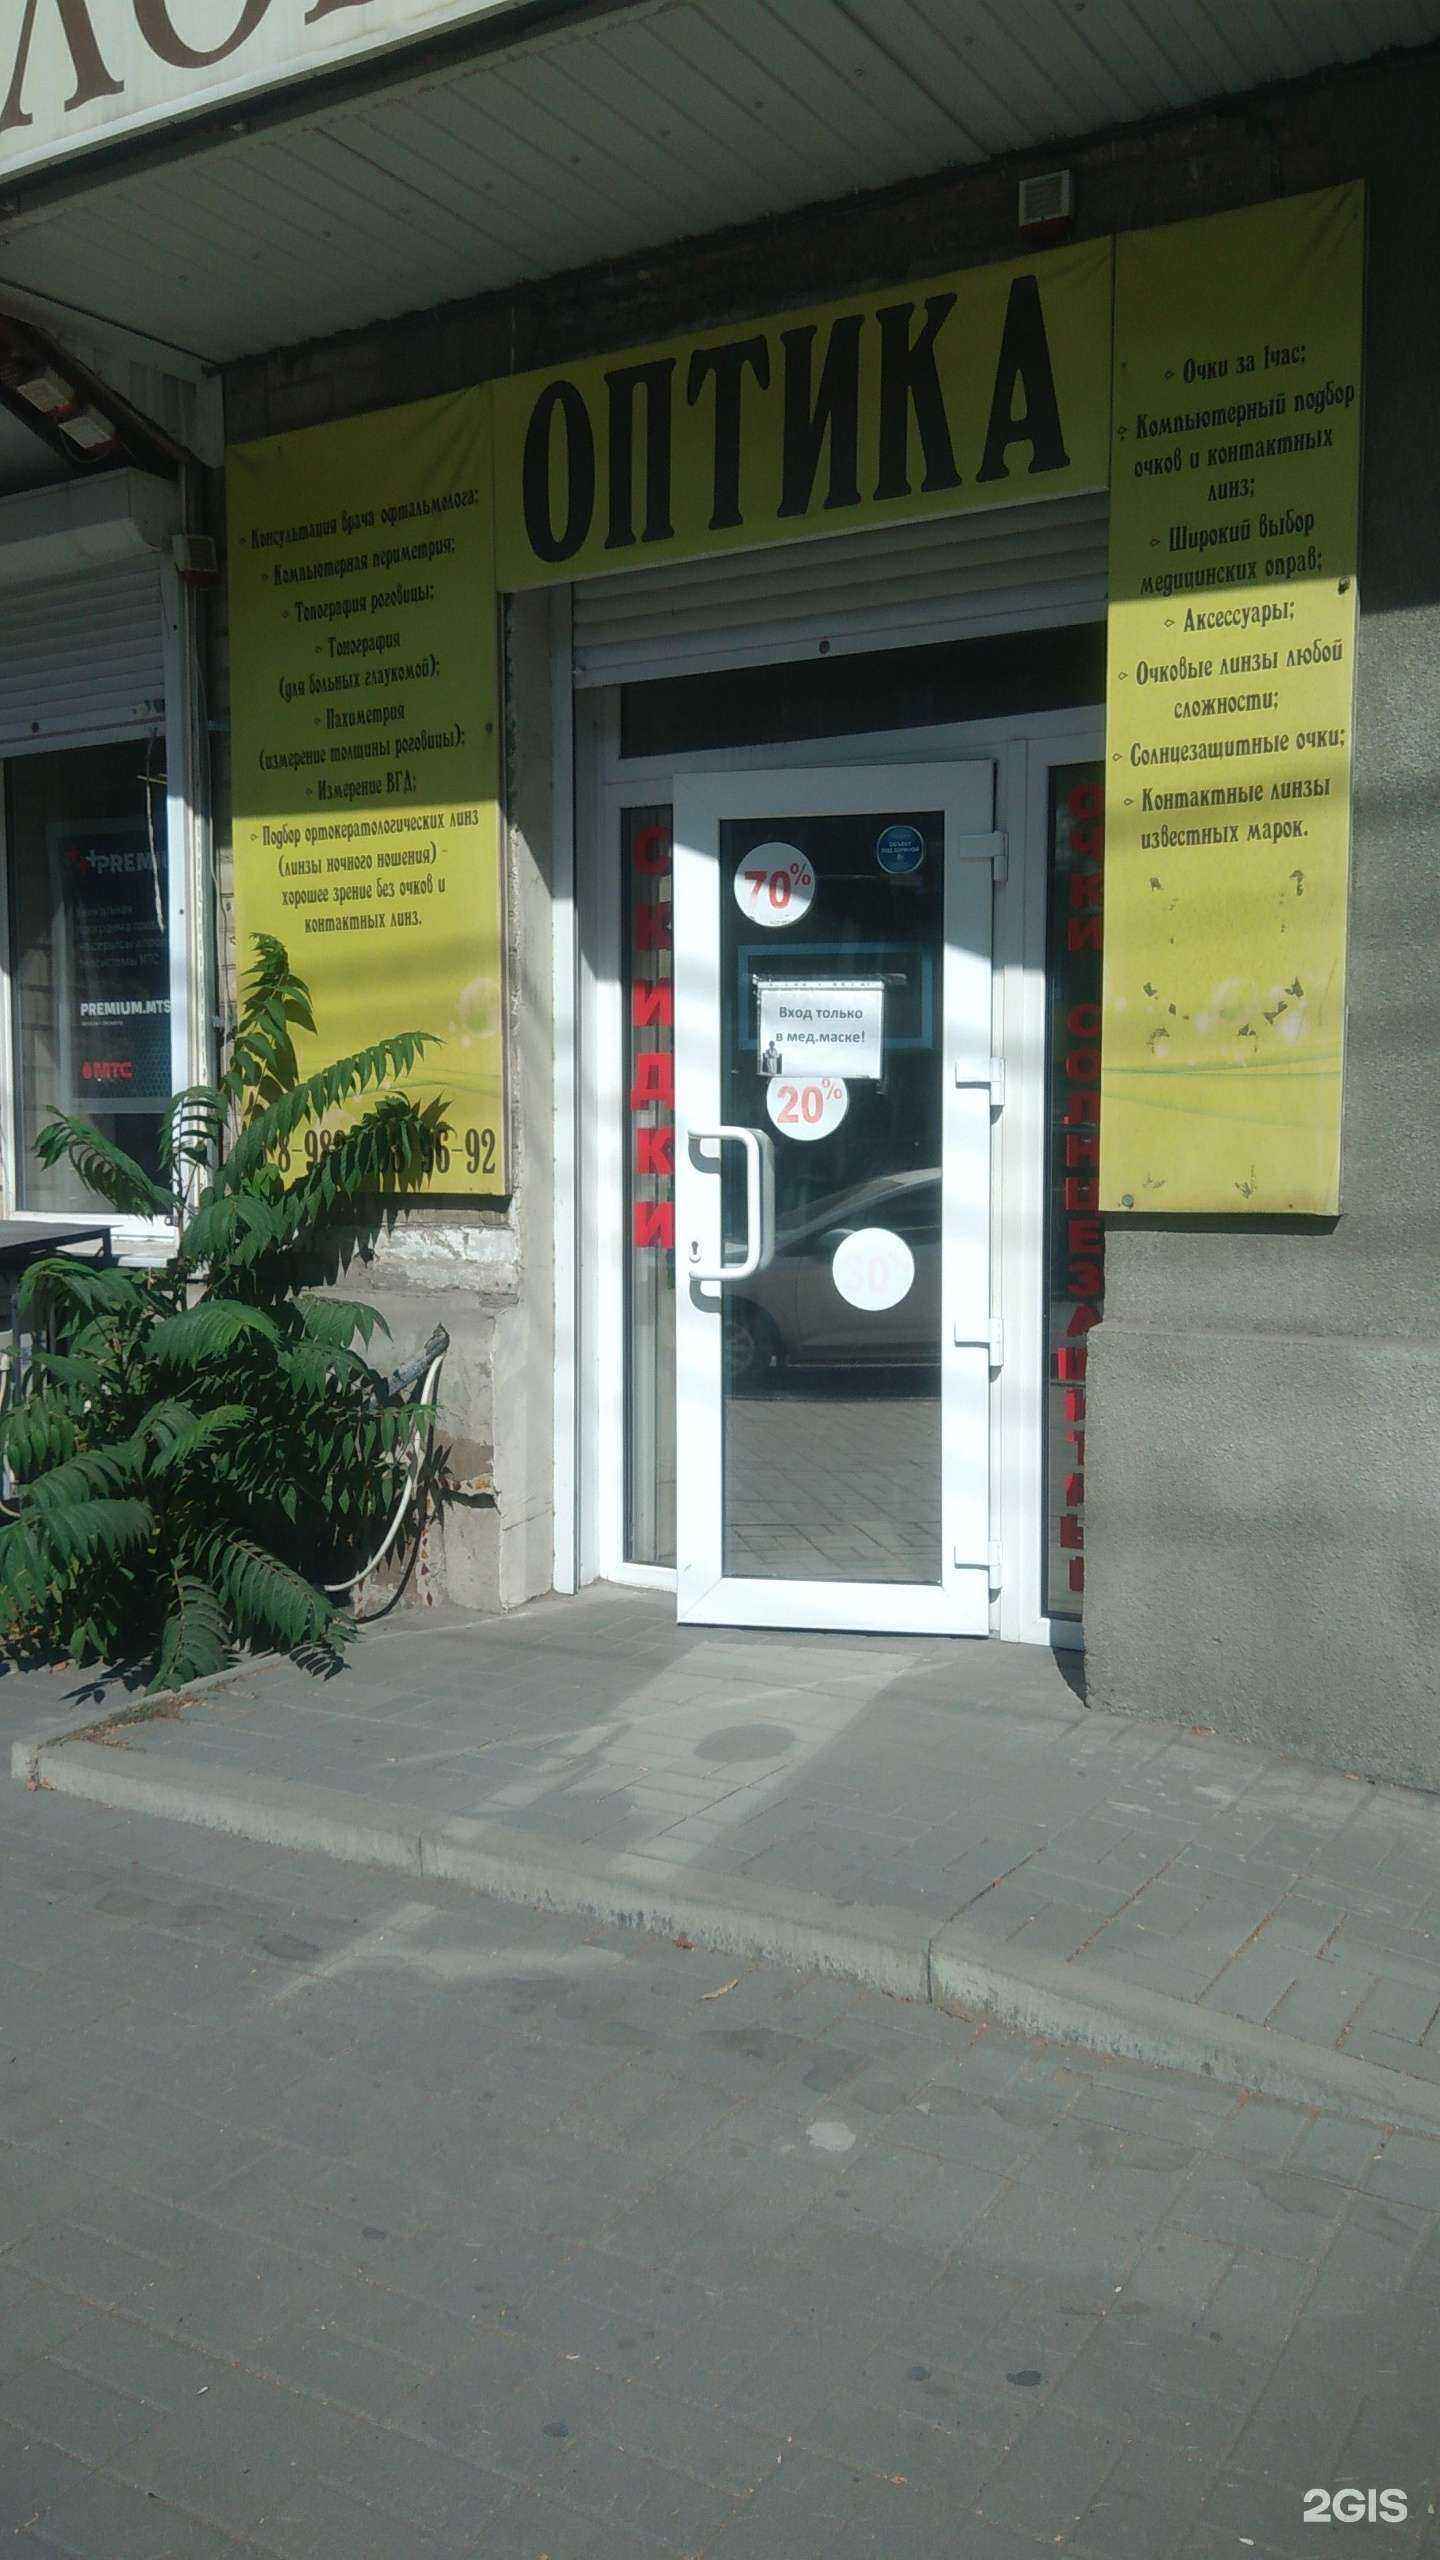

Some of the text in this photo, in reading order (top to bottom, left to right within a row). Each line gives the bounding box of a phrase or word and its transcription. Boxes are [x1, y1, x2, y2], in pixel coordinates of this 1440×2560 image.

[1183, 358, 1228, 384] Очки
[1235, 355, 1255, 374] за
[523, 275, 1071, 563] ОПТИКА
[1136, 381, 1355, 439] Компьютерный подбор
[1134, 428, 1333, 477] очков и контактных
[1169, 509, 1314, 552] Широкий выбор
[273, 554, 368, 585] Компьютерная
[1140, 545, 1323, 597] медицинских оправ;
[295, 594, 367, 622] Топография
[1136, 638, 1343, 685] Очковые линзы любой
[279, 676, 305, 703] (для
[309, 672, 359, 694] больных
[1174, 691, 1279, 719] сложности;
[326, 704, 405, 729] Пахиметрия
[258, 750, 327, 771] (измерение
[330, 740, 391, 762] толщины
[1130, 728, 1345, 767] Солнцезащитные очки;
[318, 779, 382, 802] Измерение
[1141, 778, 1330, 812] Контактные линзы
[262, 808, 479, 849] Подбор ортокератологических линз
[1141, 819, 1308, 849] известных марок.
[278, 854, 322, 877] (линзы
[326, 854, 373, 874] ночного
[376, 841, 437, 869] ношения)
[281, 873, 446, 909] хорошее зрение без очков и
[744, 863, 812, 909] 70%
[304, 909, 422, 933] контактных линз.
[779, 1006, 863, 1021] Вход только
[631, 825, 674, 1248] СКИДКИ
[776, 1030, 865, 1044] в мед.маске!
[777, 1077, 842, 1124] 20%
